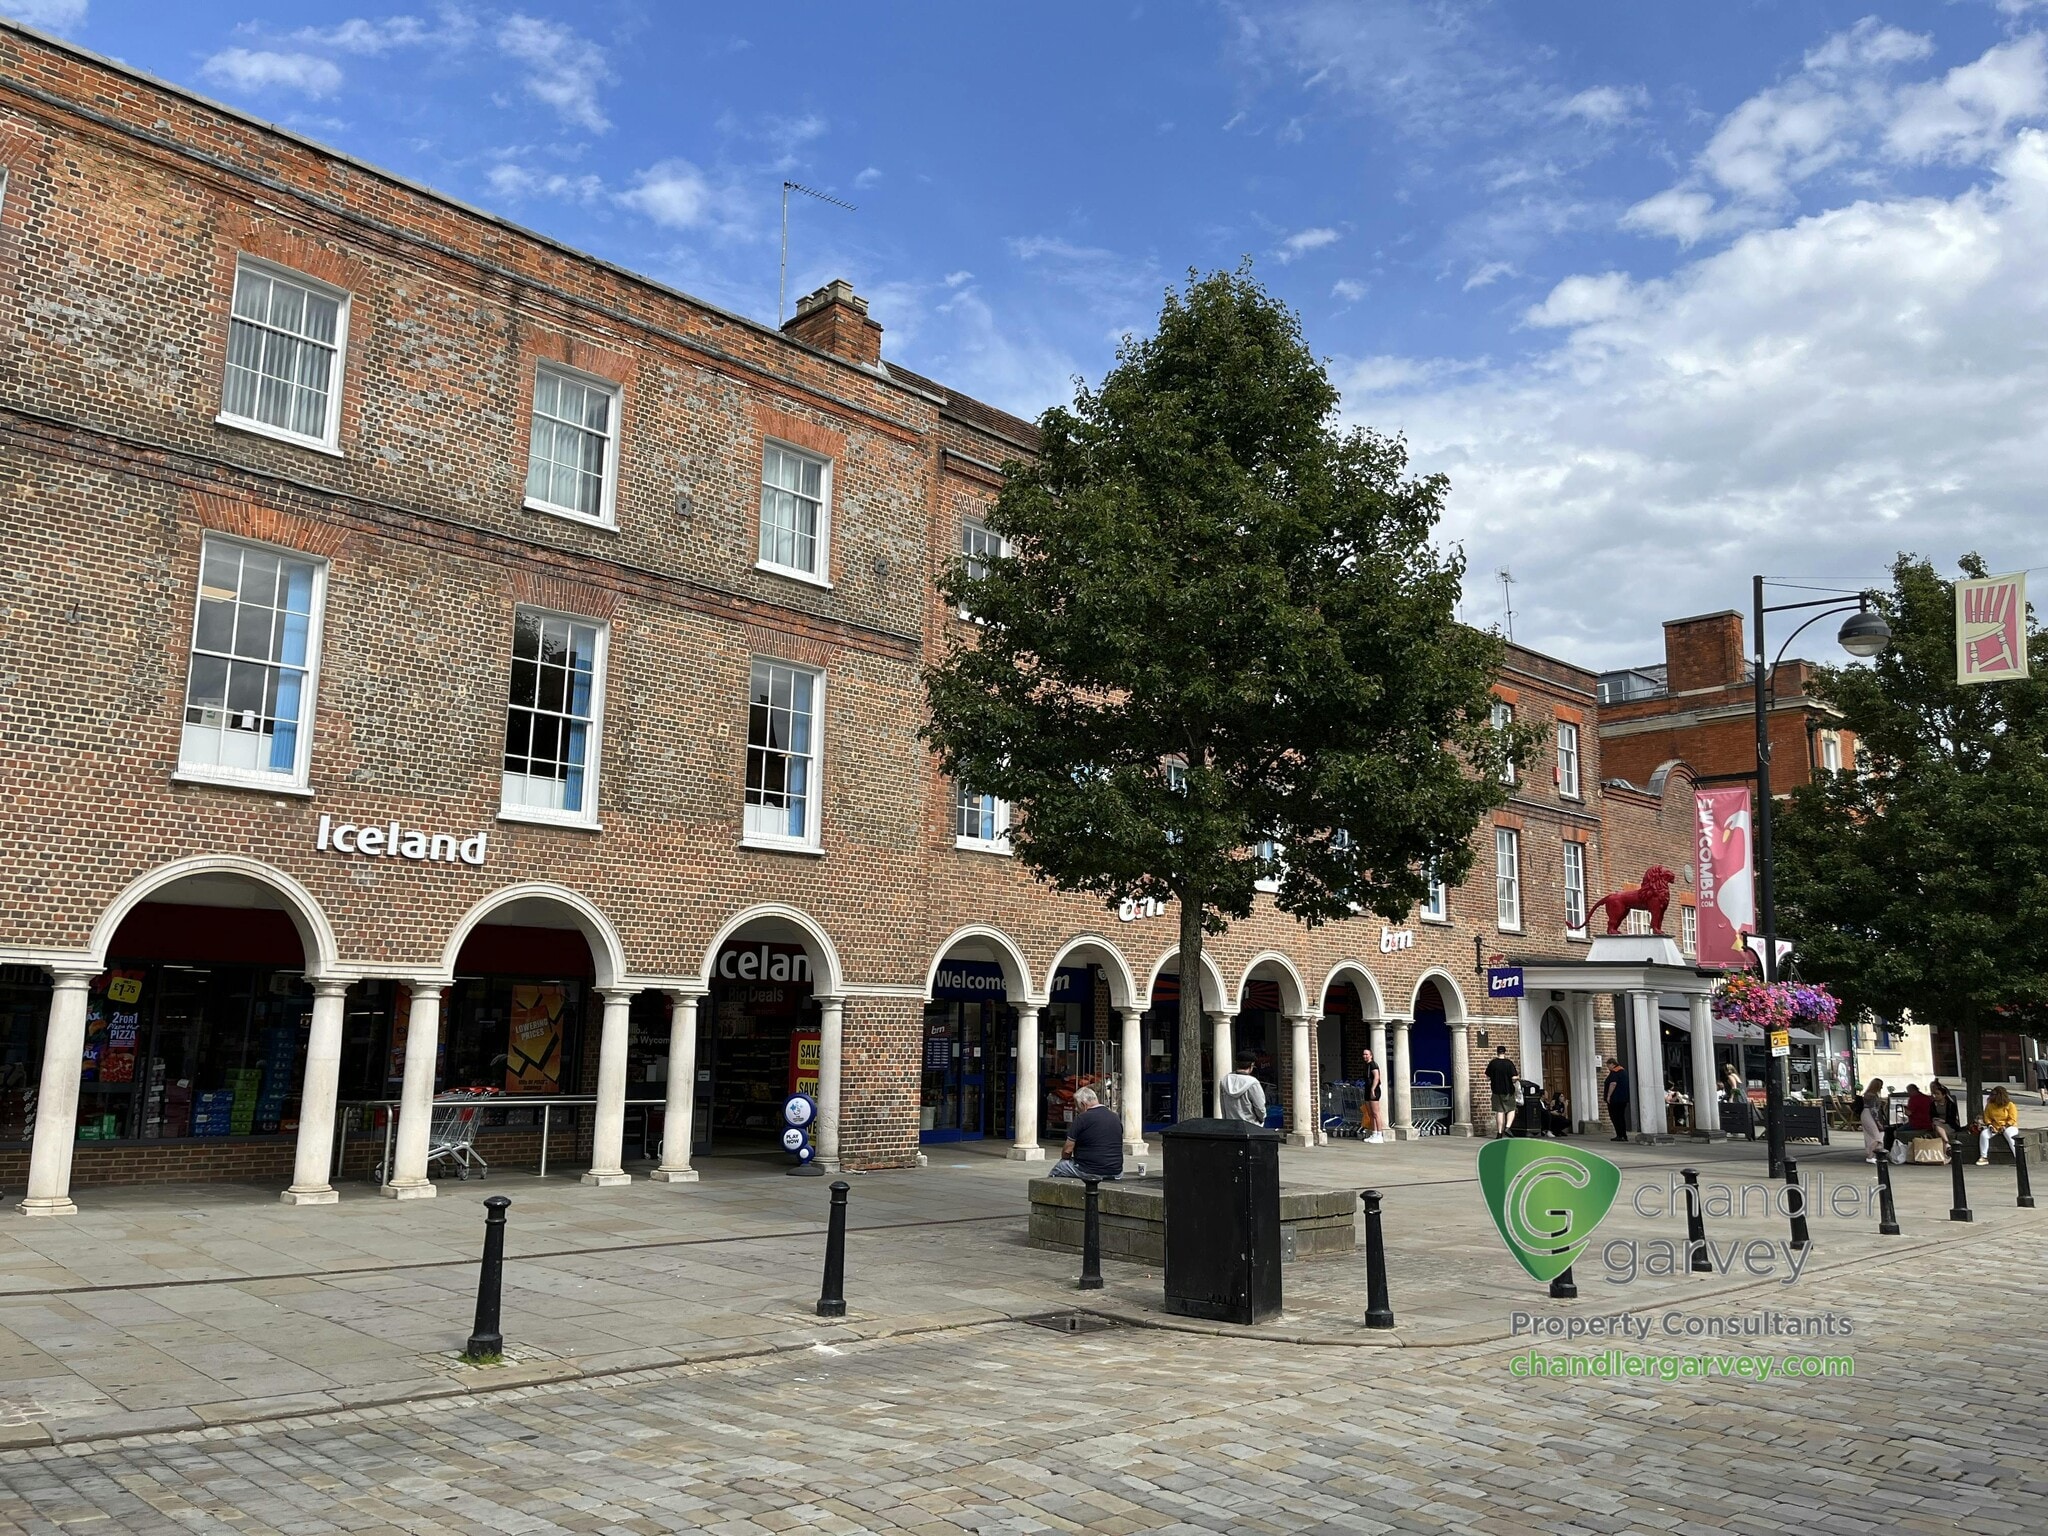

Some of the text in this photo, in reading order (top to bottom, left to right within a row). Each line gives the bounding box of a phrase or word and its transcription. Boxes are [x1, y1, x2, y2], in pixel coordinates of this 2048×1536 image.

[316, 815, 488, 865] Iceland
[1699, 809, 1713, 900] WYCOMBE
[709, 945, 812, 982] celan
[936, 970, 1007, 990] Welcome
[110, 1030, 136, 1040] PIZZA
[521, 1028, 545, 1040] PRICES
[640, 1035, 671, 1045] Wycom
[800, 1044, 820, 1059] SAVE
[799, 1081, 818, 1097] SAVE
